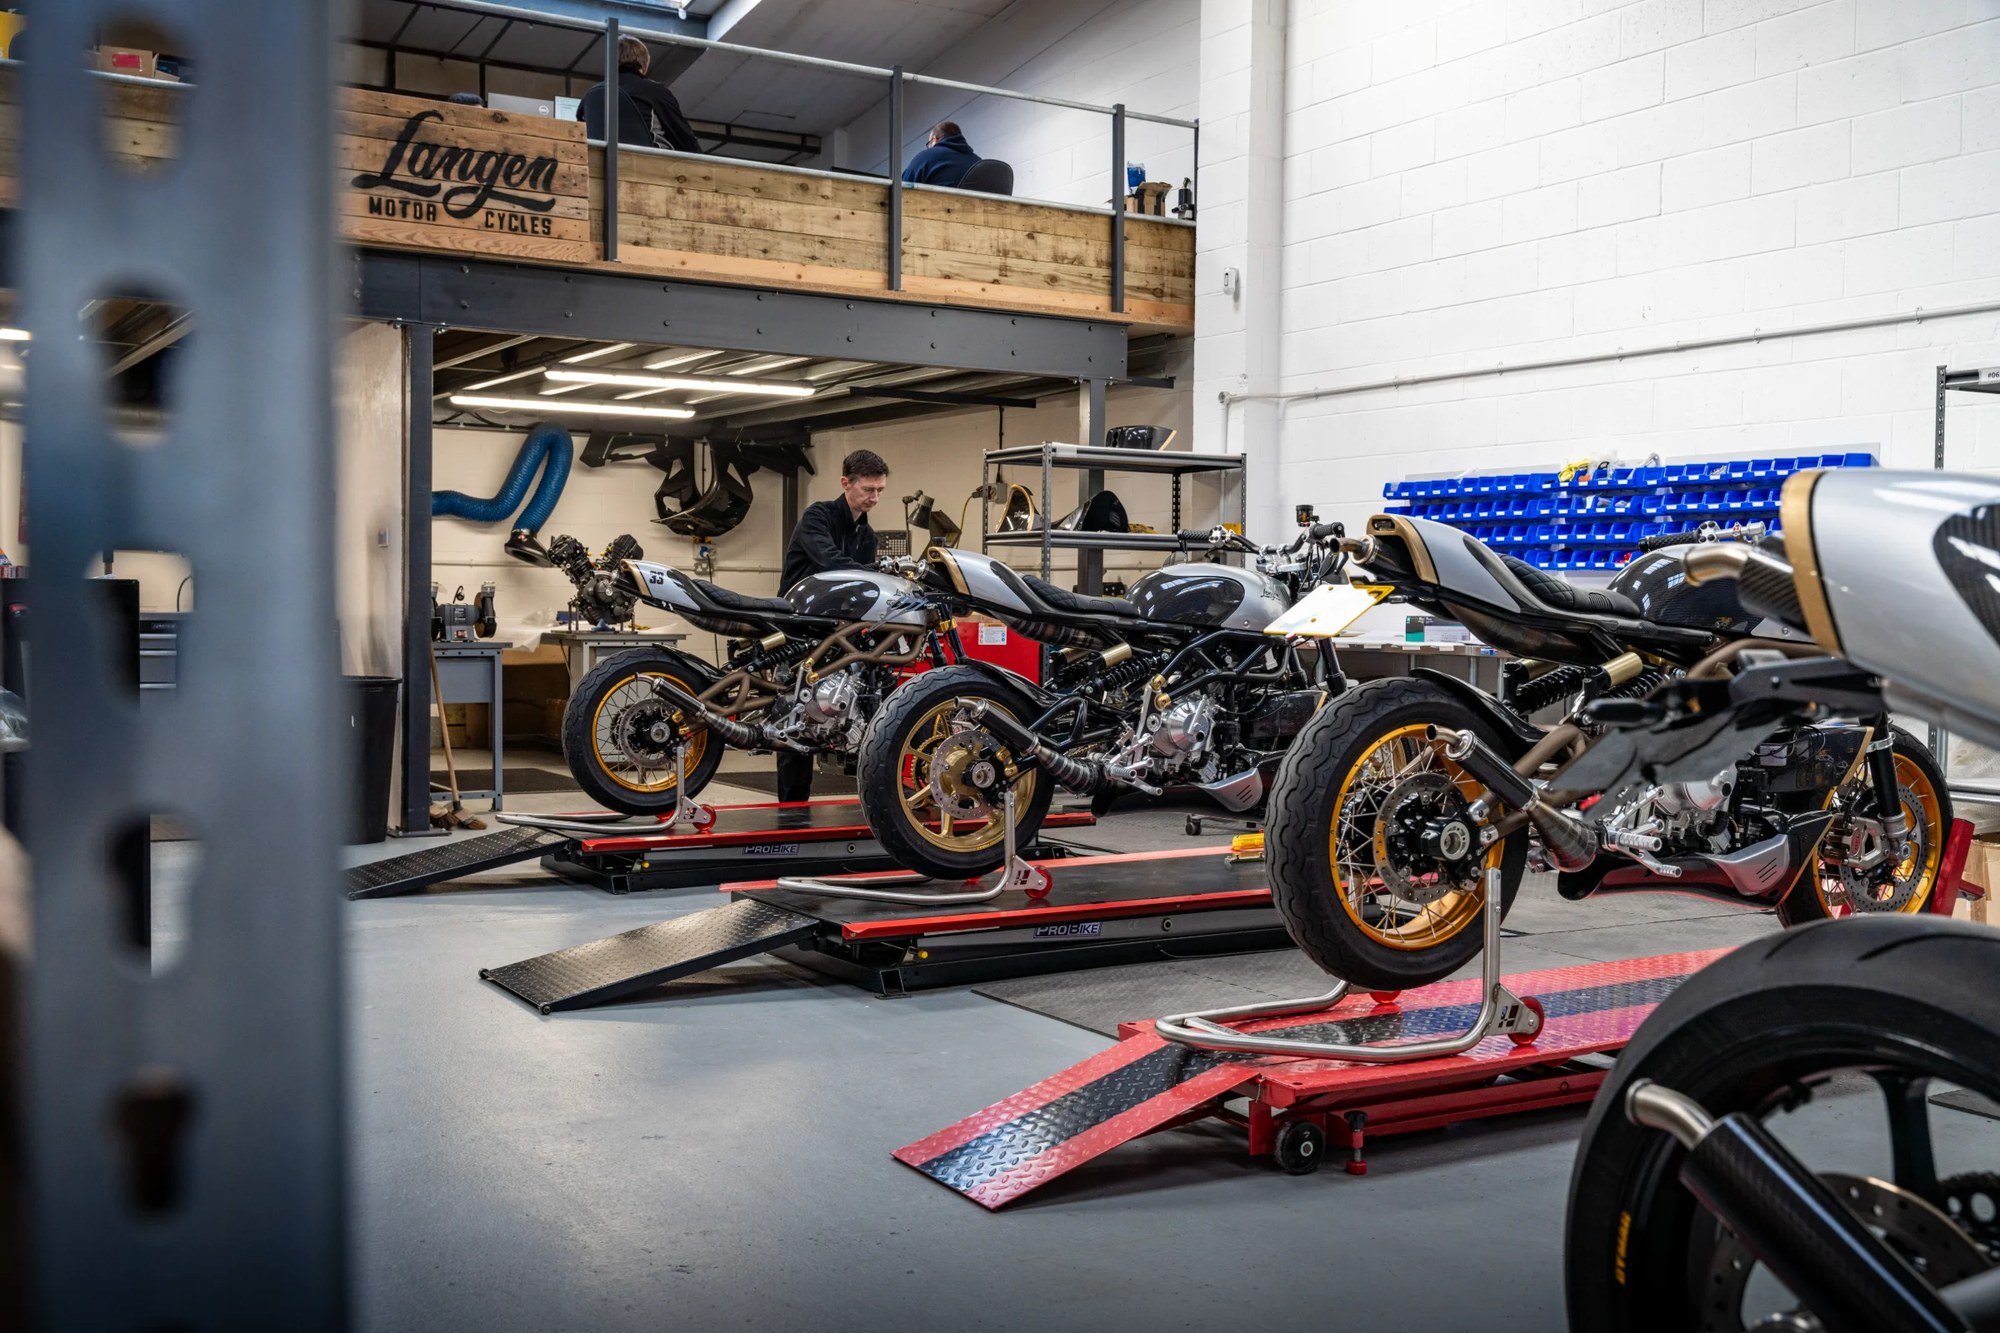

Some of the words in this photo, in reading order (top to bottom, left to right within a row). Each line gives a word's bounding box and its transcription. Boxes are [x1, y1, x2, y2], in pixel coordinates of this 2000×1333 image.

[352, 110, 559, 219] Langen
[369, 196, 437, 222] MOTOR
[485, 211, 552, 236] CYCLES
